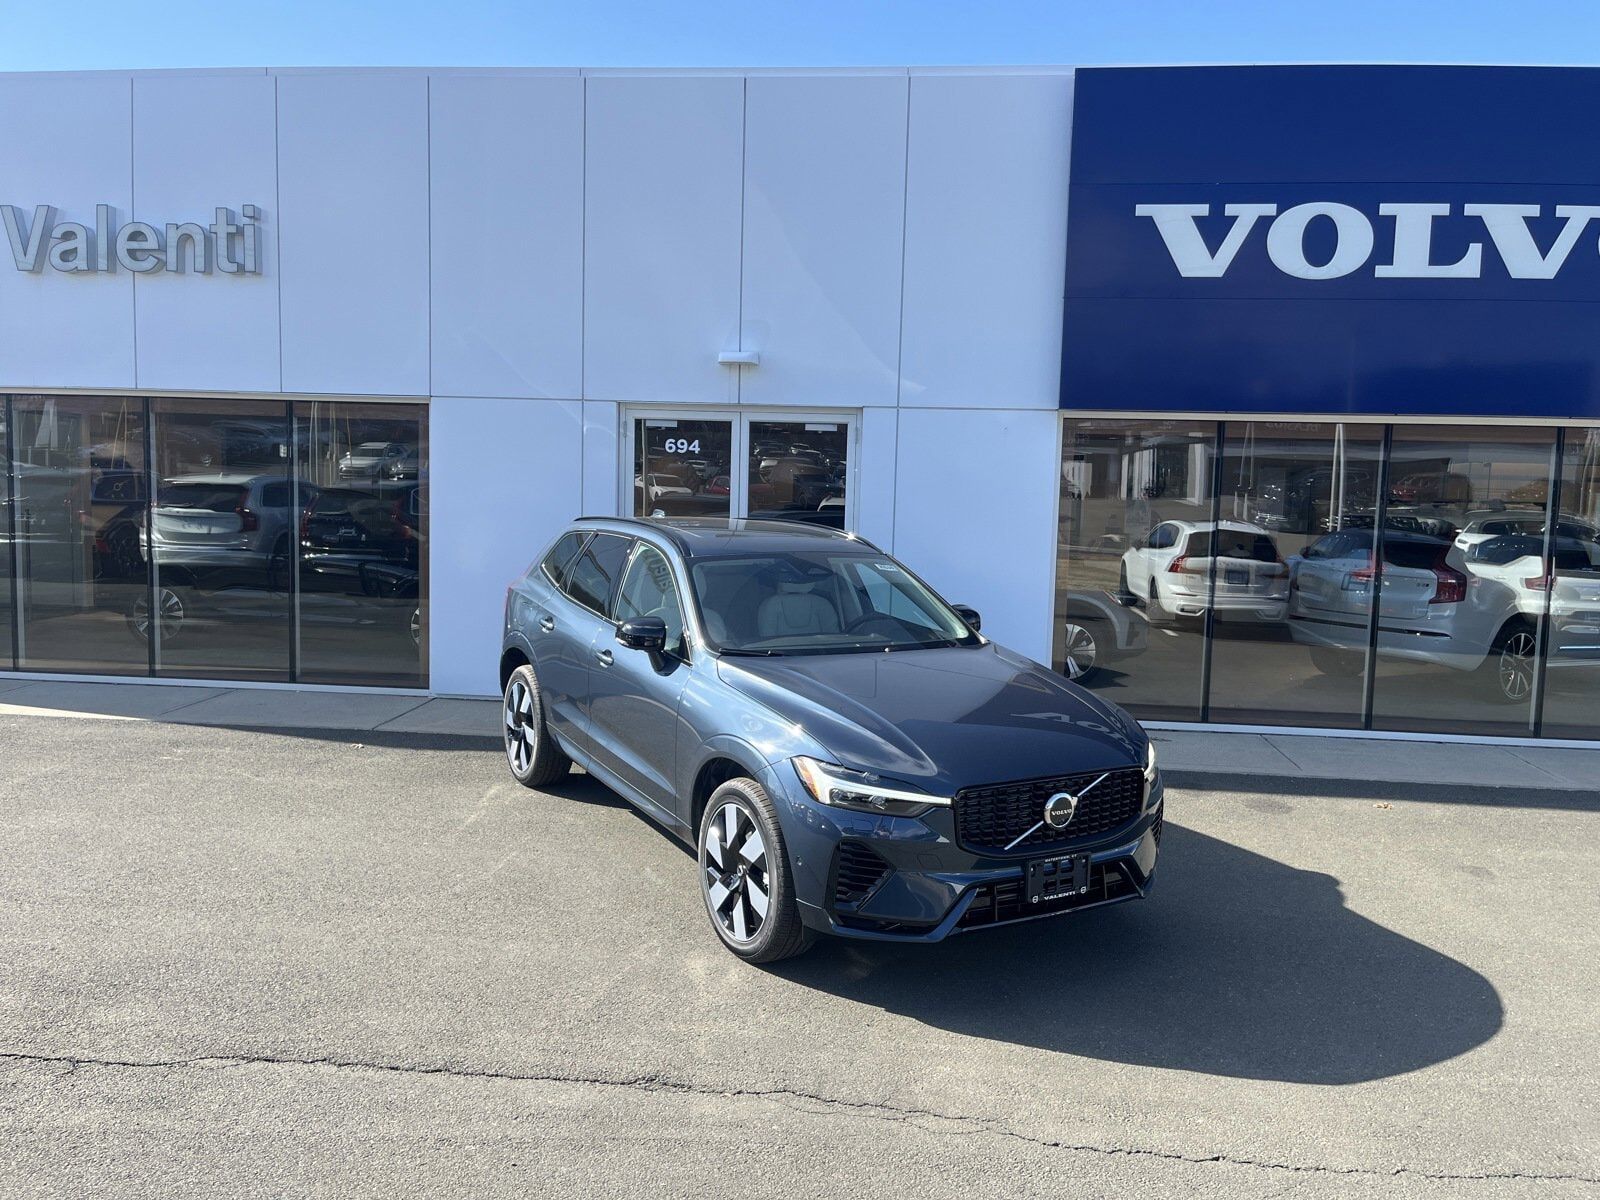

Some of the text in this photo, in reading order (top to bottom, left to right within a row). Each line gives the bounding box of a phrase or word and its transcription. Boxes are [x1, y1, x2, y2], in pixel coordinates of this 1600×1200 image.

[0, 203, 261, 274] Valenti
[1135, 201, 1600, 280] VOLV
[664, 438, 701, 454] 694
[1043, 891, 1076, 901] VALENTI
